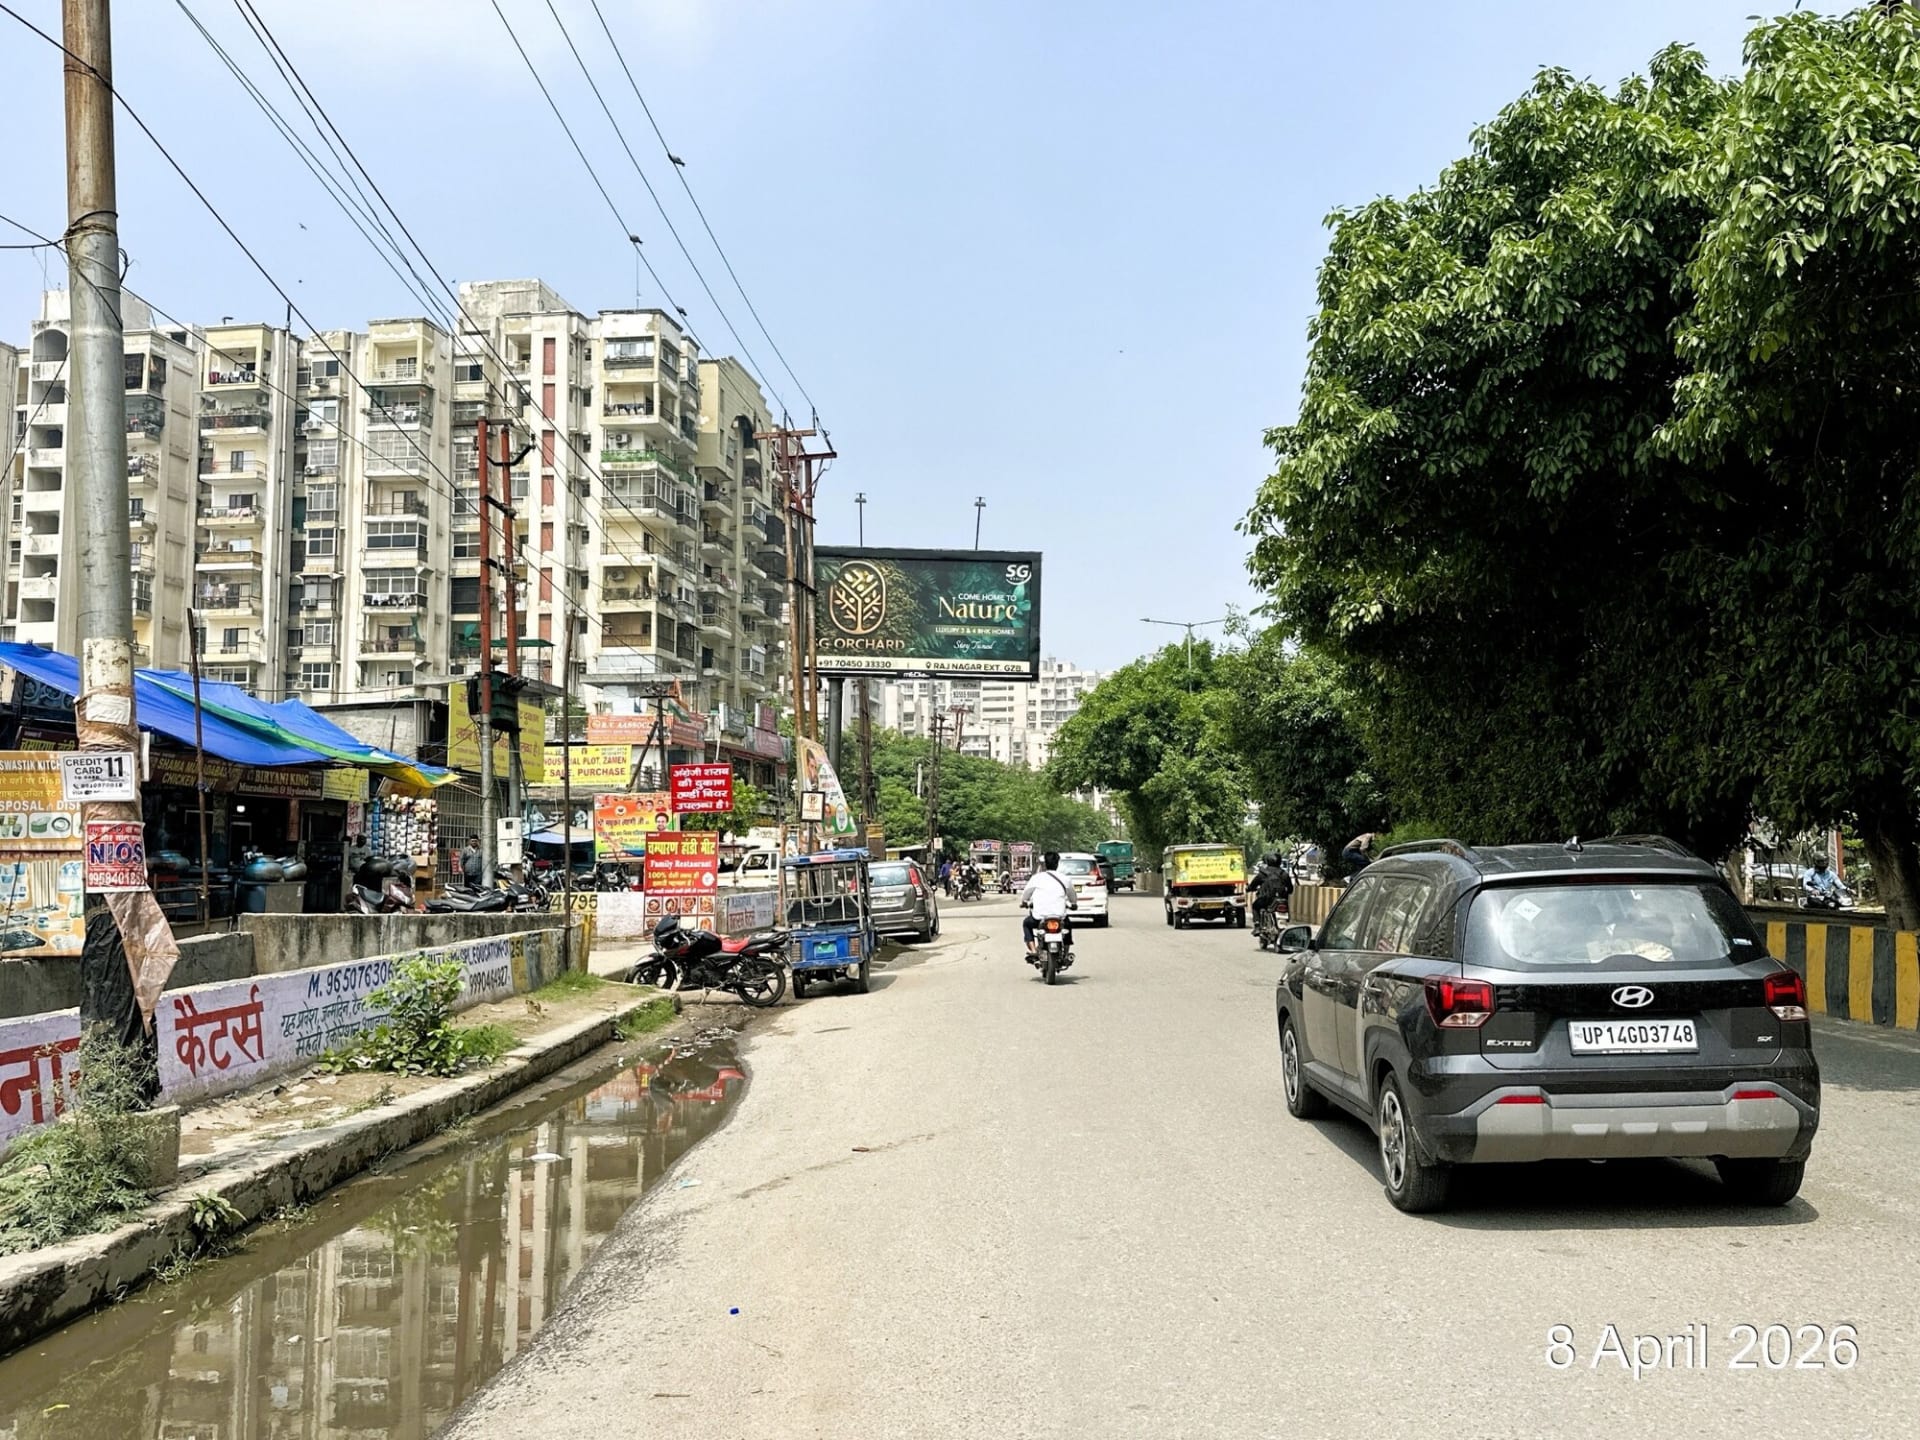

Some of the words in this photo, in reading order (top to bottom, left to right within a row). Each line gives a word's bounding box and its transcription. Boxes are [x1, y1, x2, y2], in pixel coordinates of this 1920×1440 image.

[1006, 564, 1029, 578] SG
[958, 592, 980, 600] COME
[981, 593, 1005, 601] HOME
[1006, 594, 1017, 602] TO
[938, 596, 1018, 620] Nature
[834, 638, 905, 650] ORCHARD
[835, 660, 863, 668] 70450
[864, 661, 892, 669] 33330
[933, 662, 950, 670] RAJ
[951, 663, 982, 671] NAGAR
[0, 759, 36, 771] SWASTIK
[65, 757, 102, 767] CREDIT
[74, 766, 103, 775] CARD
[577, 768, 626, 777] PURCHASE
[162, 773, 197, 787] CHICKEN
[255, 769, 288, 785] BIRYANI
[290, 773, 309, 787] KING
[677, 778, 692, 787] की
[694, 779, 726, 790] दुकान
[647, 841, 679, 855] चम्पारण
[681, 838, 698, 855] हांडी
[700, 838, 716, 855] मीट
[90, 842, 144, 865] NIOS
[650, 860, 673, 870] Family
[674, 860, 712, 868] Restaurant
[550, 894, 598, 910] 4795
[174, 983, 265, 1078] कैटर्स
[1582, 1024, 1694, 1045] UP14GD3748
[1486, 1039, 1532, 1047] EXTER
[1757, 1035, 1774, 1043] SX
